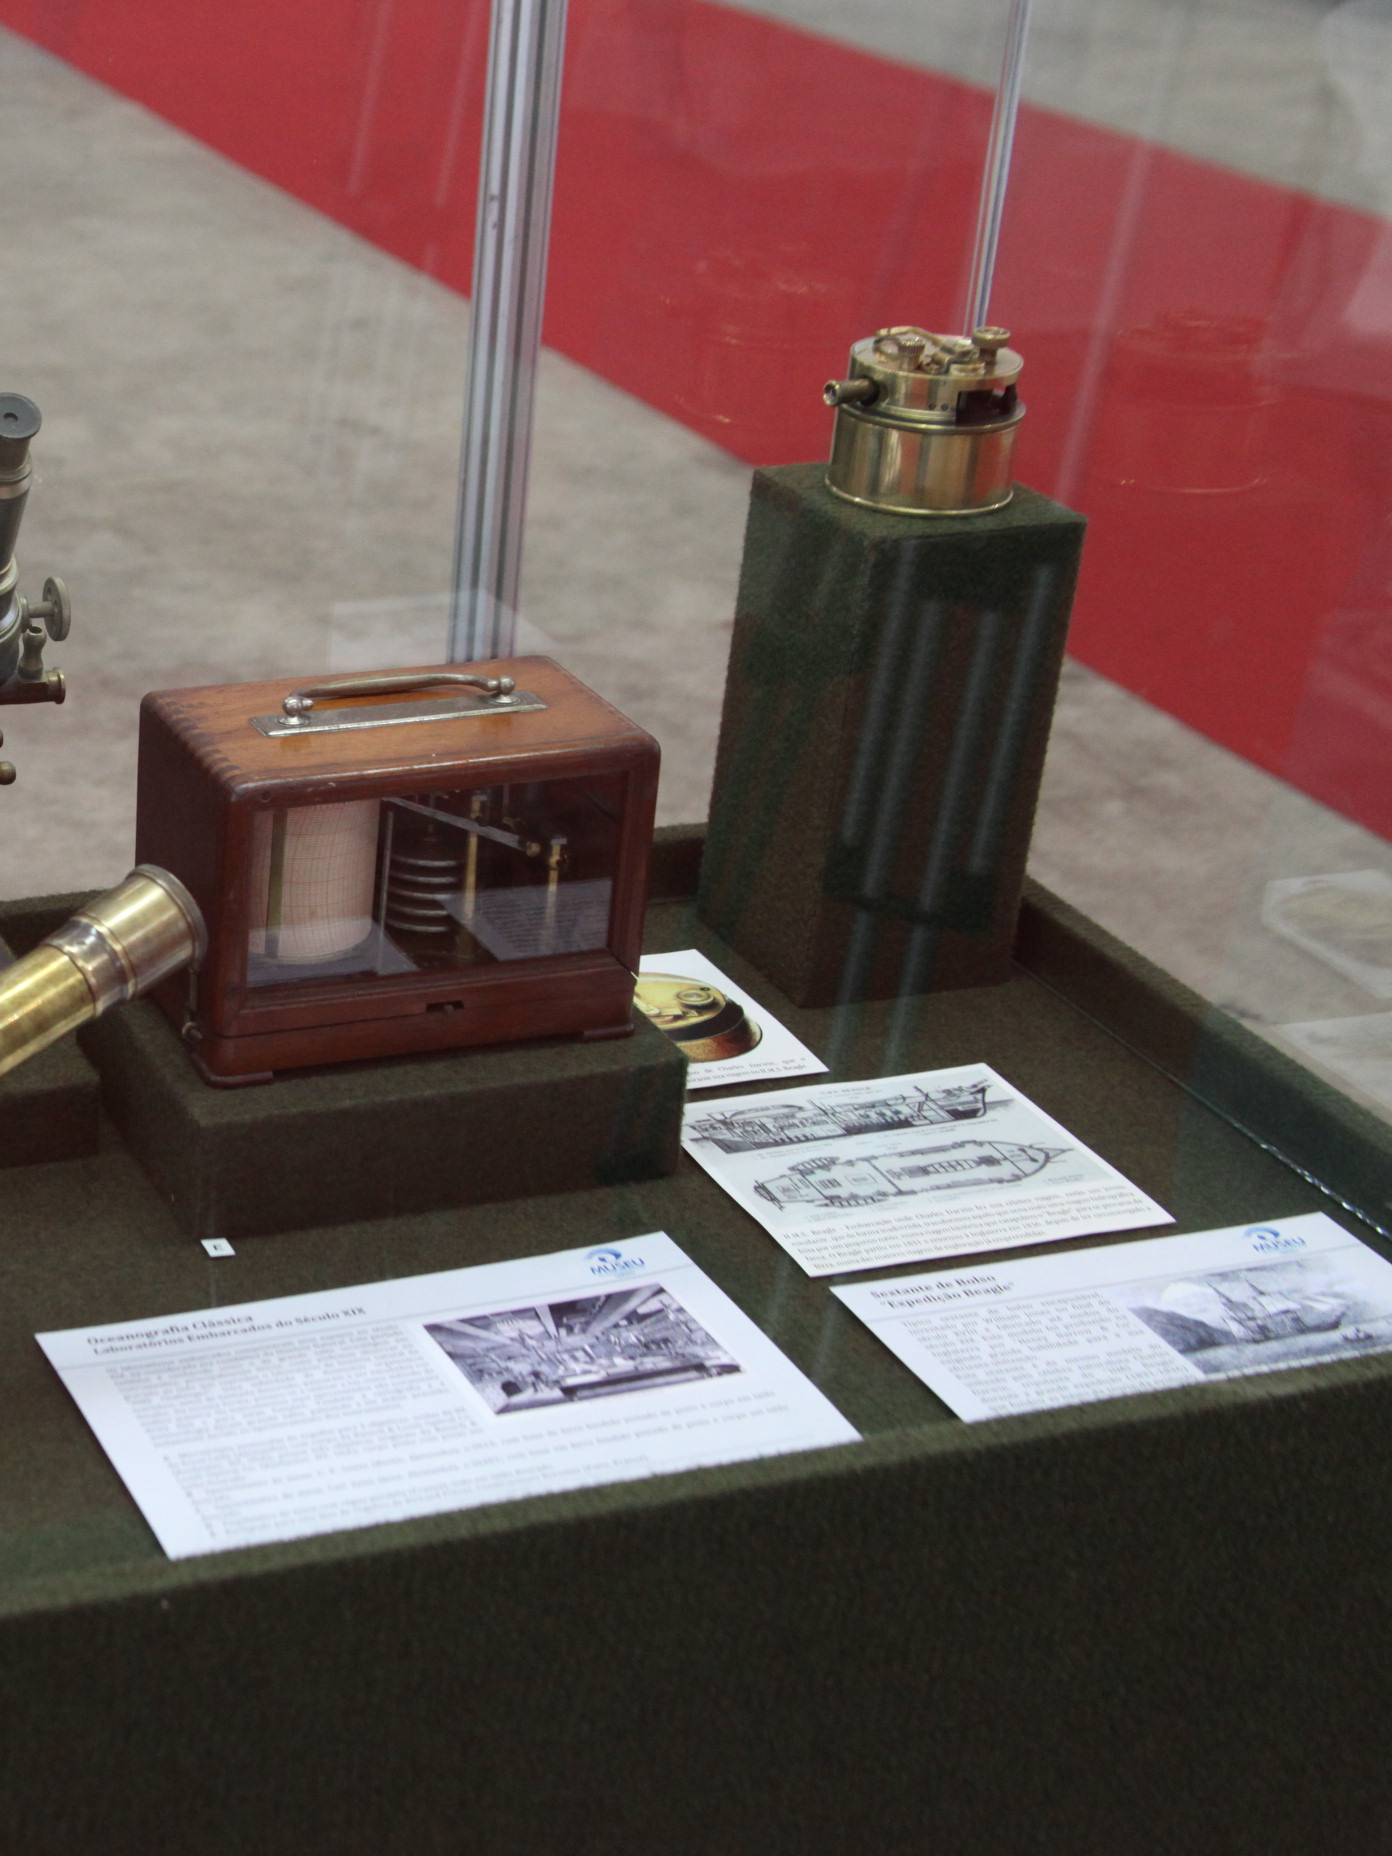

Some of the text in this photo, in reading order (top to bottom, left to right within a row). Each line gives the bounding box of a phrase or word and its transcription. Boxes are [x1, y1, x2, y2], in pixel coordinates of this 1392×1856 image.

[589, 1256, 646, 1276] MUSEU
[870, 1273, 997, 1300] Sextante de Bolso
[879, 1280, 1016, 1311] "Expedição Beagle"
[86, 1314, 254, 1347] Oceanografia Clássica
[92, 1306, 366, 1356] Laboratórios Embarcados do Século XIX
